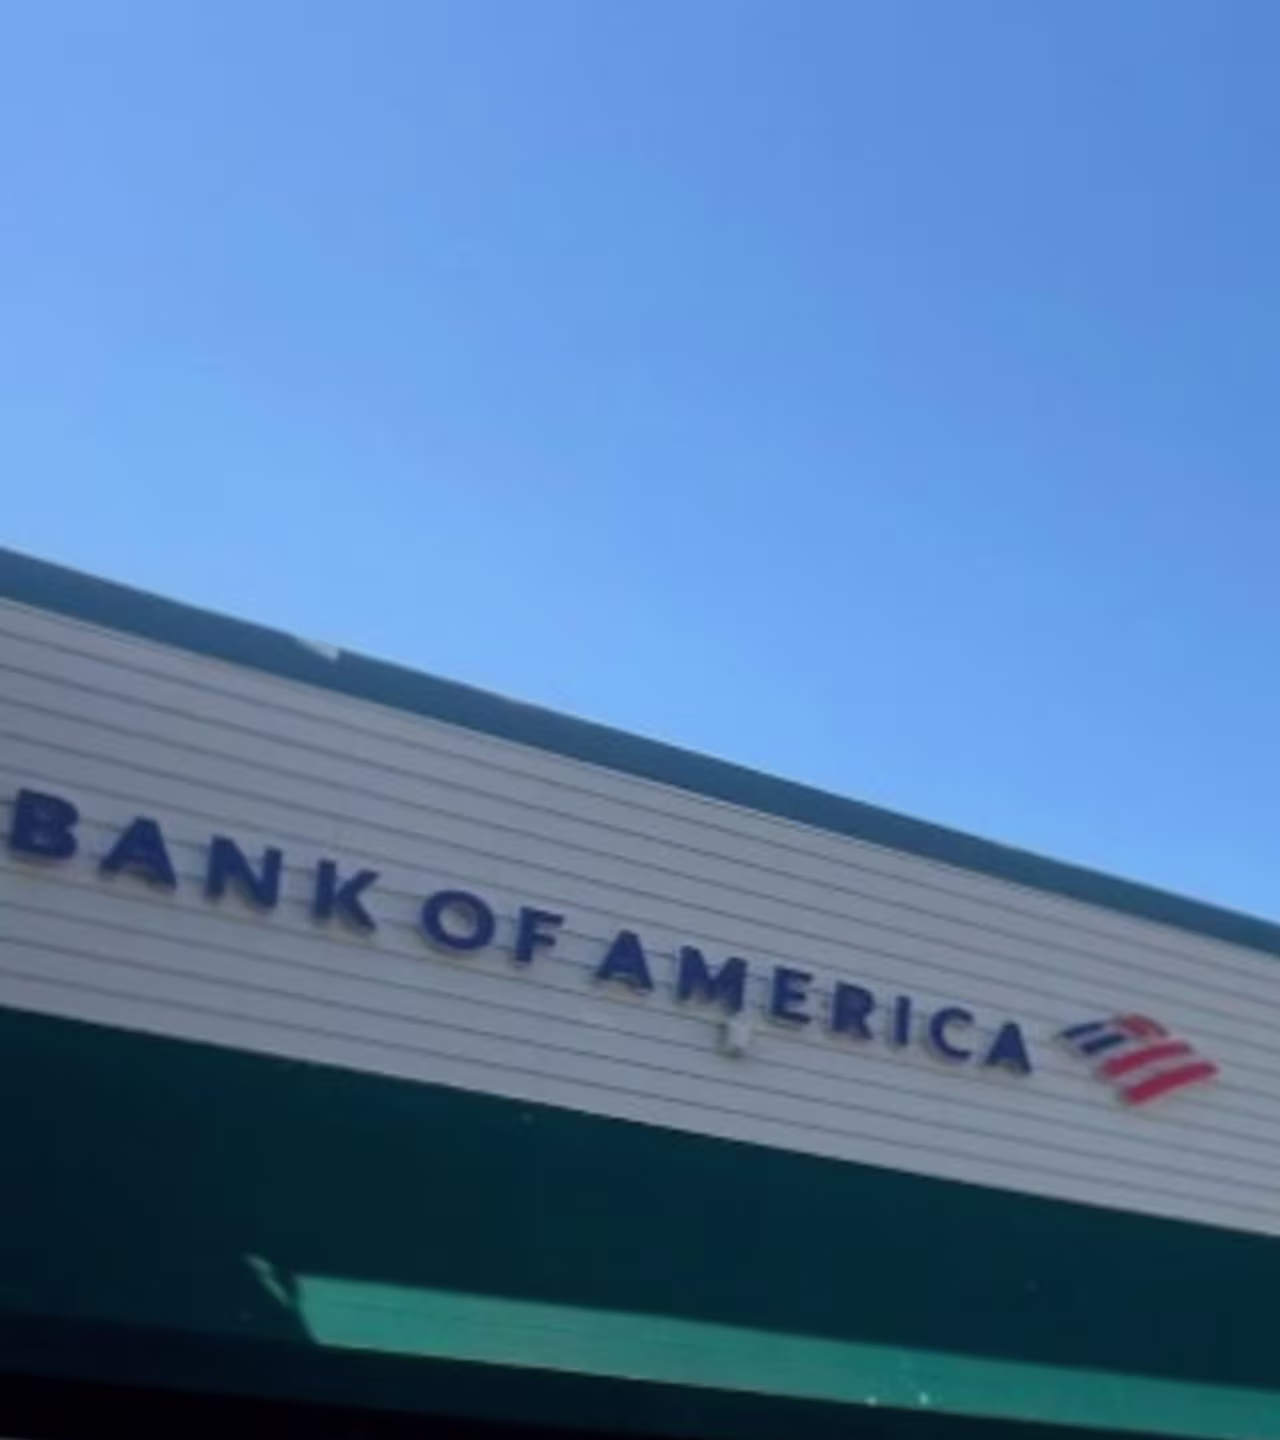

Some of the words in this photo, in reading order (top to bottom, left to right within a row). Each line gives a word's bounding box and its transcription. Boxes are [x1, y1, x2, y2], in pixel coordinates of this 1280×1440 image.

[8, 786, 380, 933] BANK
[419, 888, 564, 965] OF
[594, 929, 1034, 1076] AMERICA
